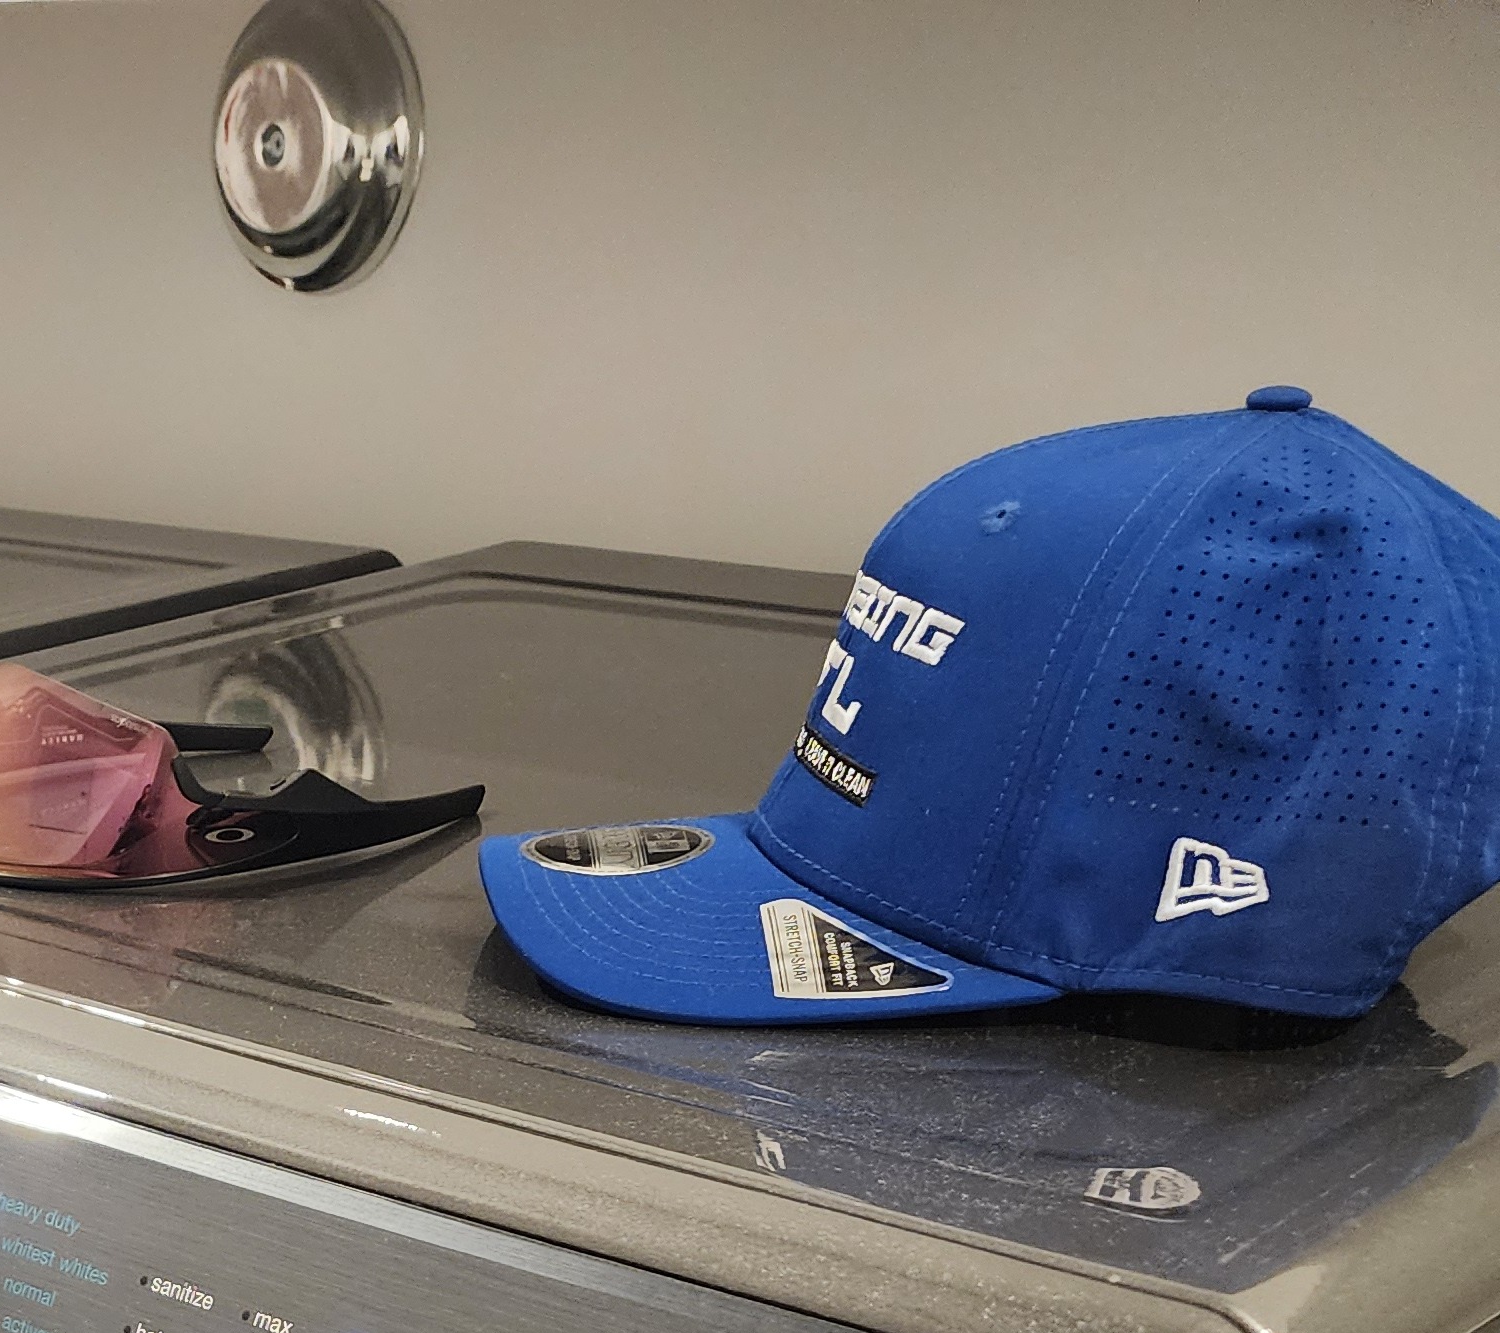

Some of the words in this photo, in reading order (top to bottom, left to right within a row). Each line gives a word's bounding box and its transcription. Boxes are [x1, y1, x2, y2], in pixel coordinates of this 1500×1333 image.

[843, 570, 966, 666] BING
[823, 932, 841, 972] COMFORT
[840, 941, 859, 987] SNAPBACK
[830, 972, 844, 987] FIT
[45, 1209, 82, 1237] duty
[2, 1236, 55, 1267] whitest
[59, 1253, 108, 1285] whites
[3, 1276, 56, 1307] normal
[150, 1276, 214, 1311] sanitize
